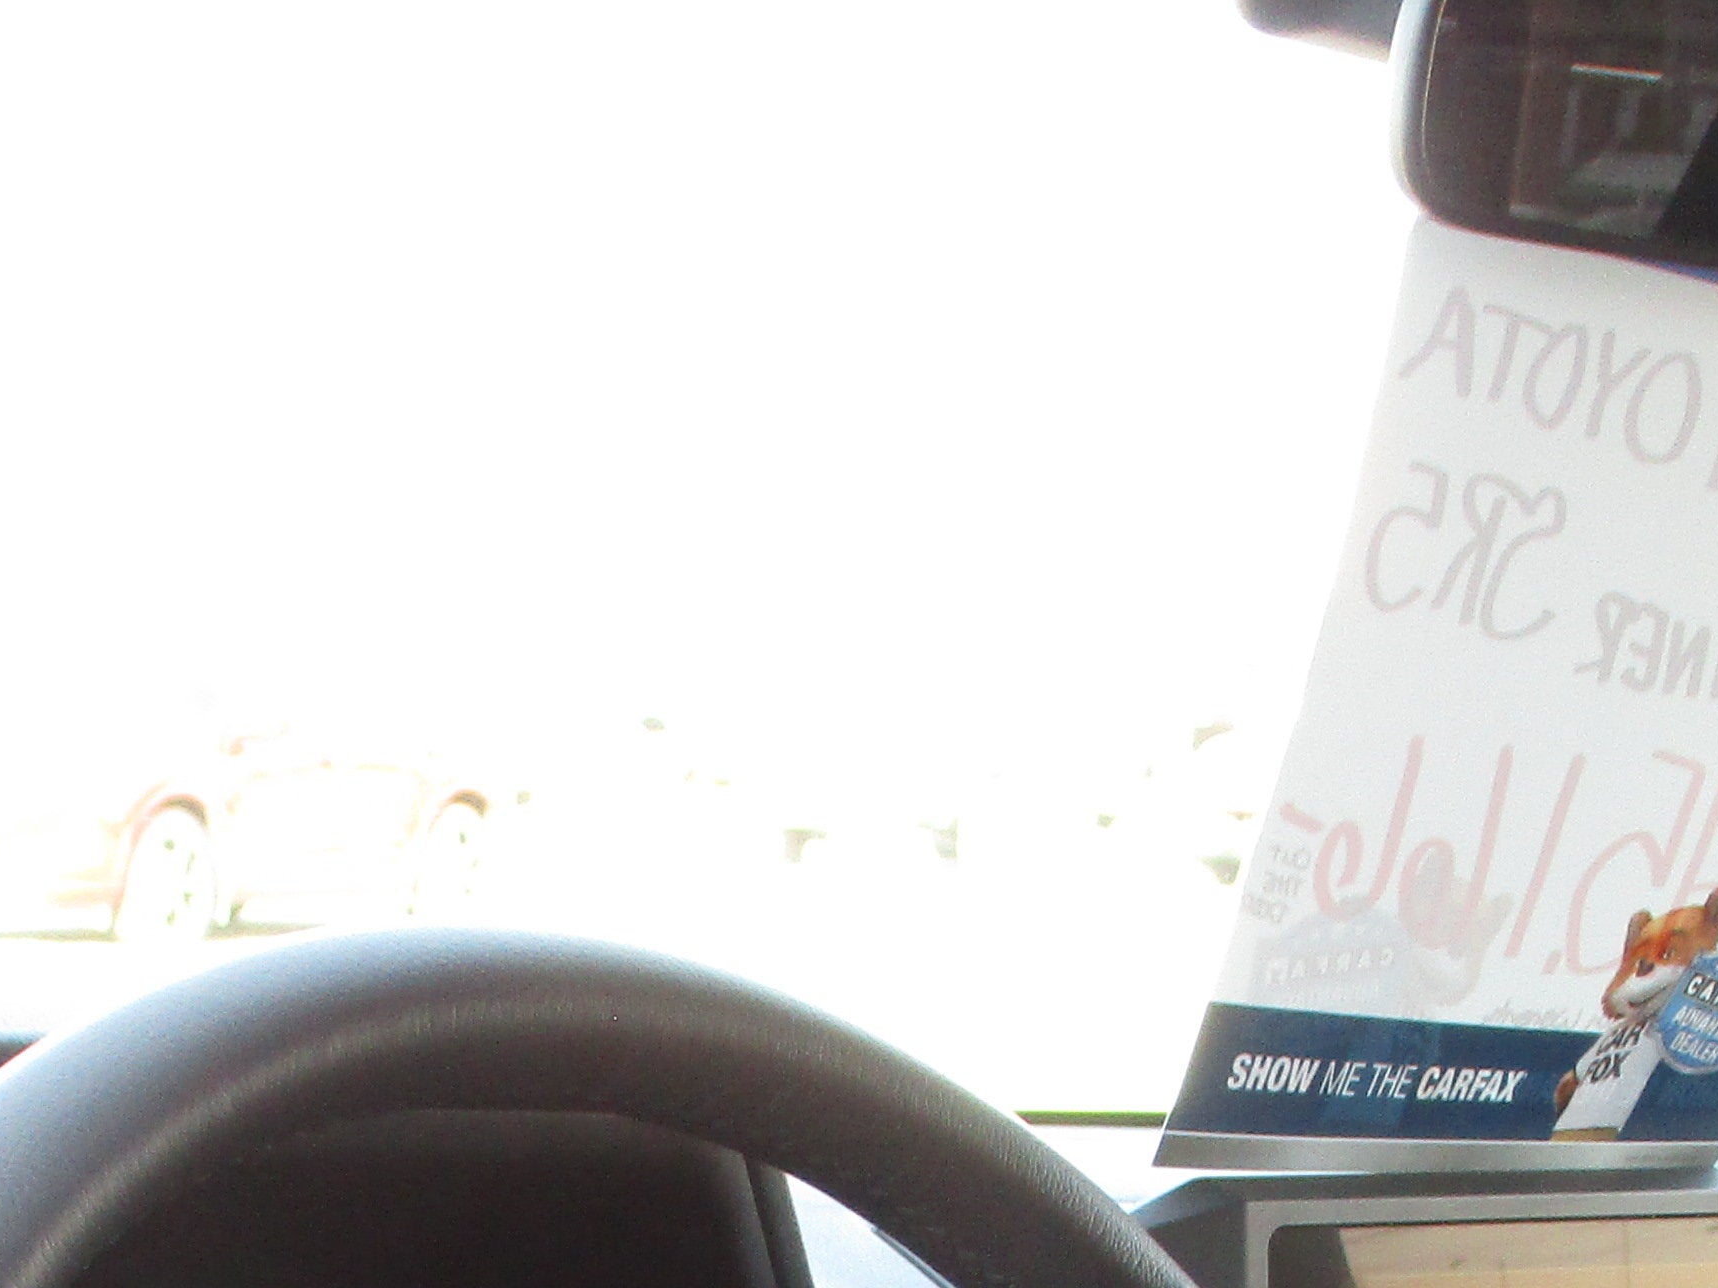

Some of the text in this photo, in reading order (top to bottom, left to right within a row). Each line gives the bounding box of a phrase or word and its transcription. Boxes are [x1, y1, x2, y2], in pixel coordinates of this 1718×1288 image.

[1227, 1053, 1525, 1103] SHOW ME THE CARFAX
